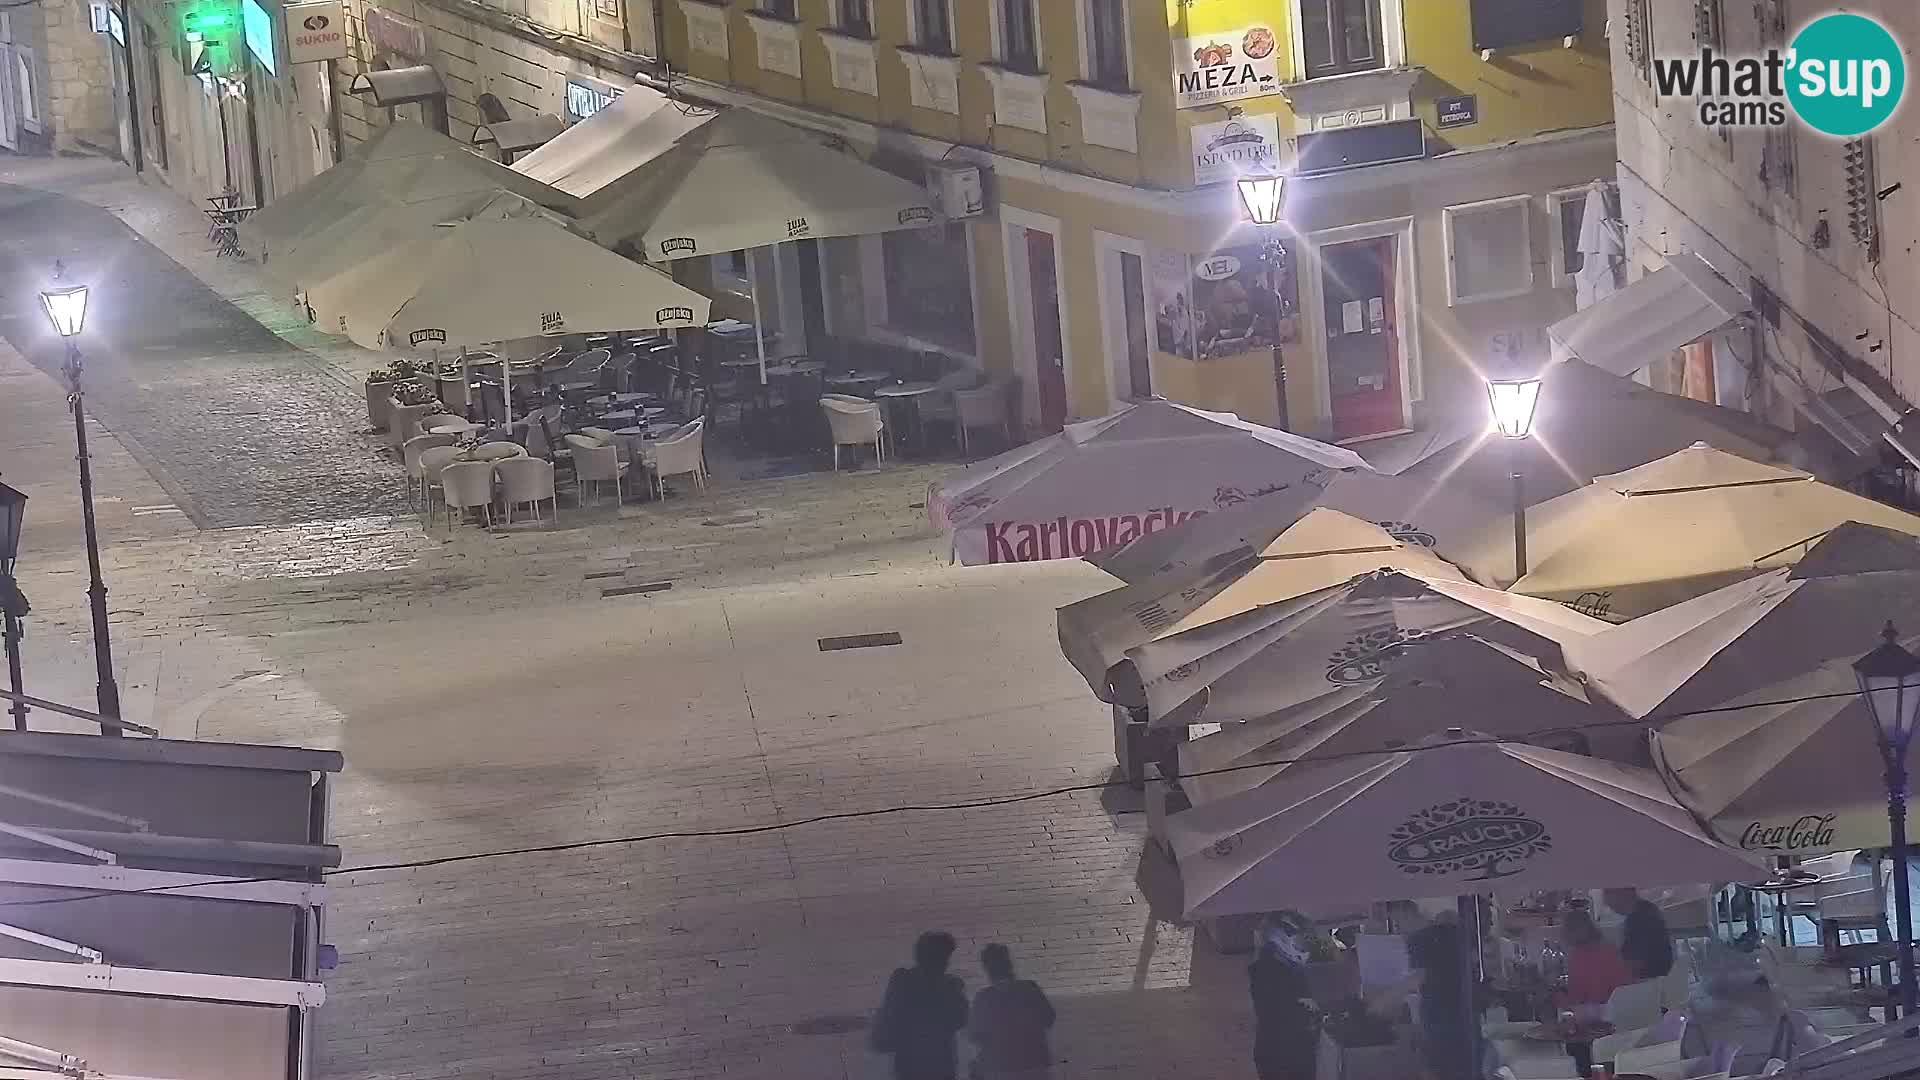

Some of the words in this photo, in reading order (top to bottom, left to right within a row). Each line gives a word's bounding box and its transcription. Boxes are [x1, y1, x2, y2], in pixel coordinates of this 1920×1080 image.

[296, 33, 340, 46] SUKNO
[1179, 63, 1258, 94] MEZA
[1187, 90, 1220, 101] PIZZERIA
[1228, 86, 1249, 96] GRILL
